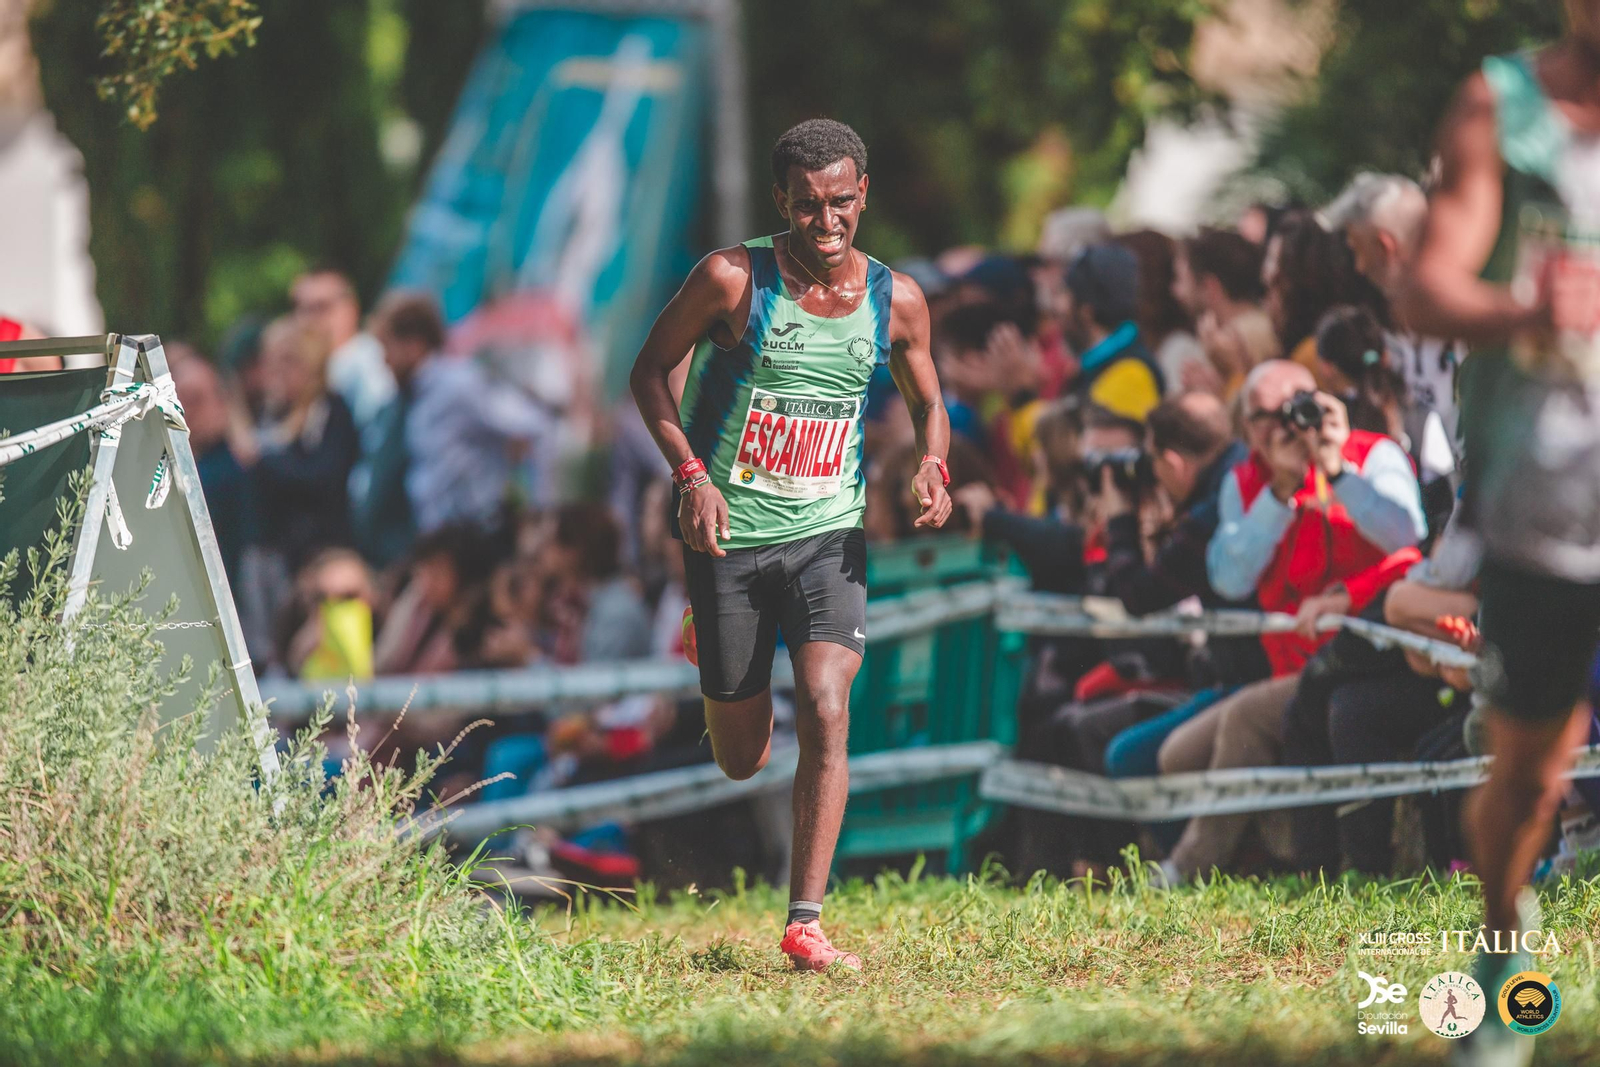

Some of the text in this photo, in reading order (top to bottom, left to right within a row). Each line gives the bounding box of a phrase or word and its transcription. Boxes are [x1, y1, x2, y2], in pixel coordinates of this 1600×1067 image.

[770, 341, 804, 351] UCLM
[784, 400, 834, 415] ITÁLICA
[737, 410, 850, 478] ESCAMILLA
